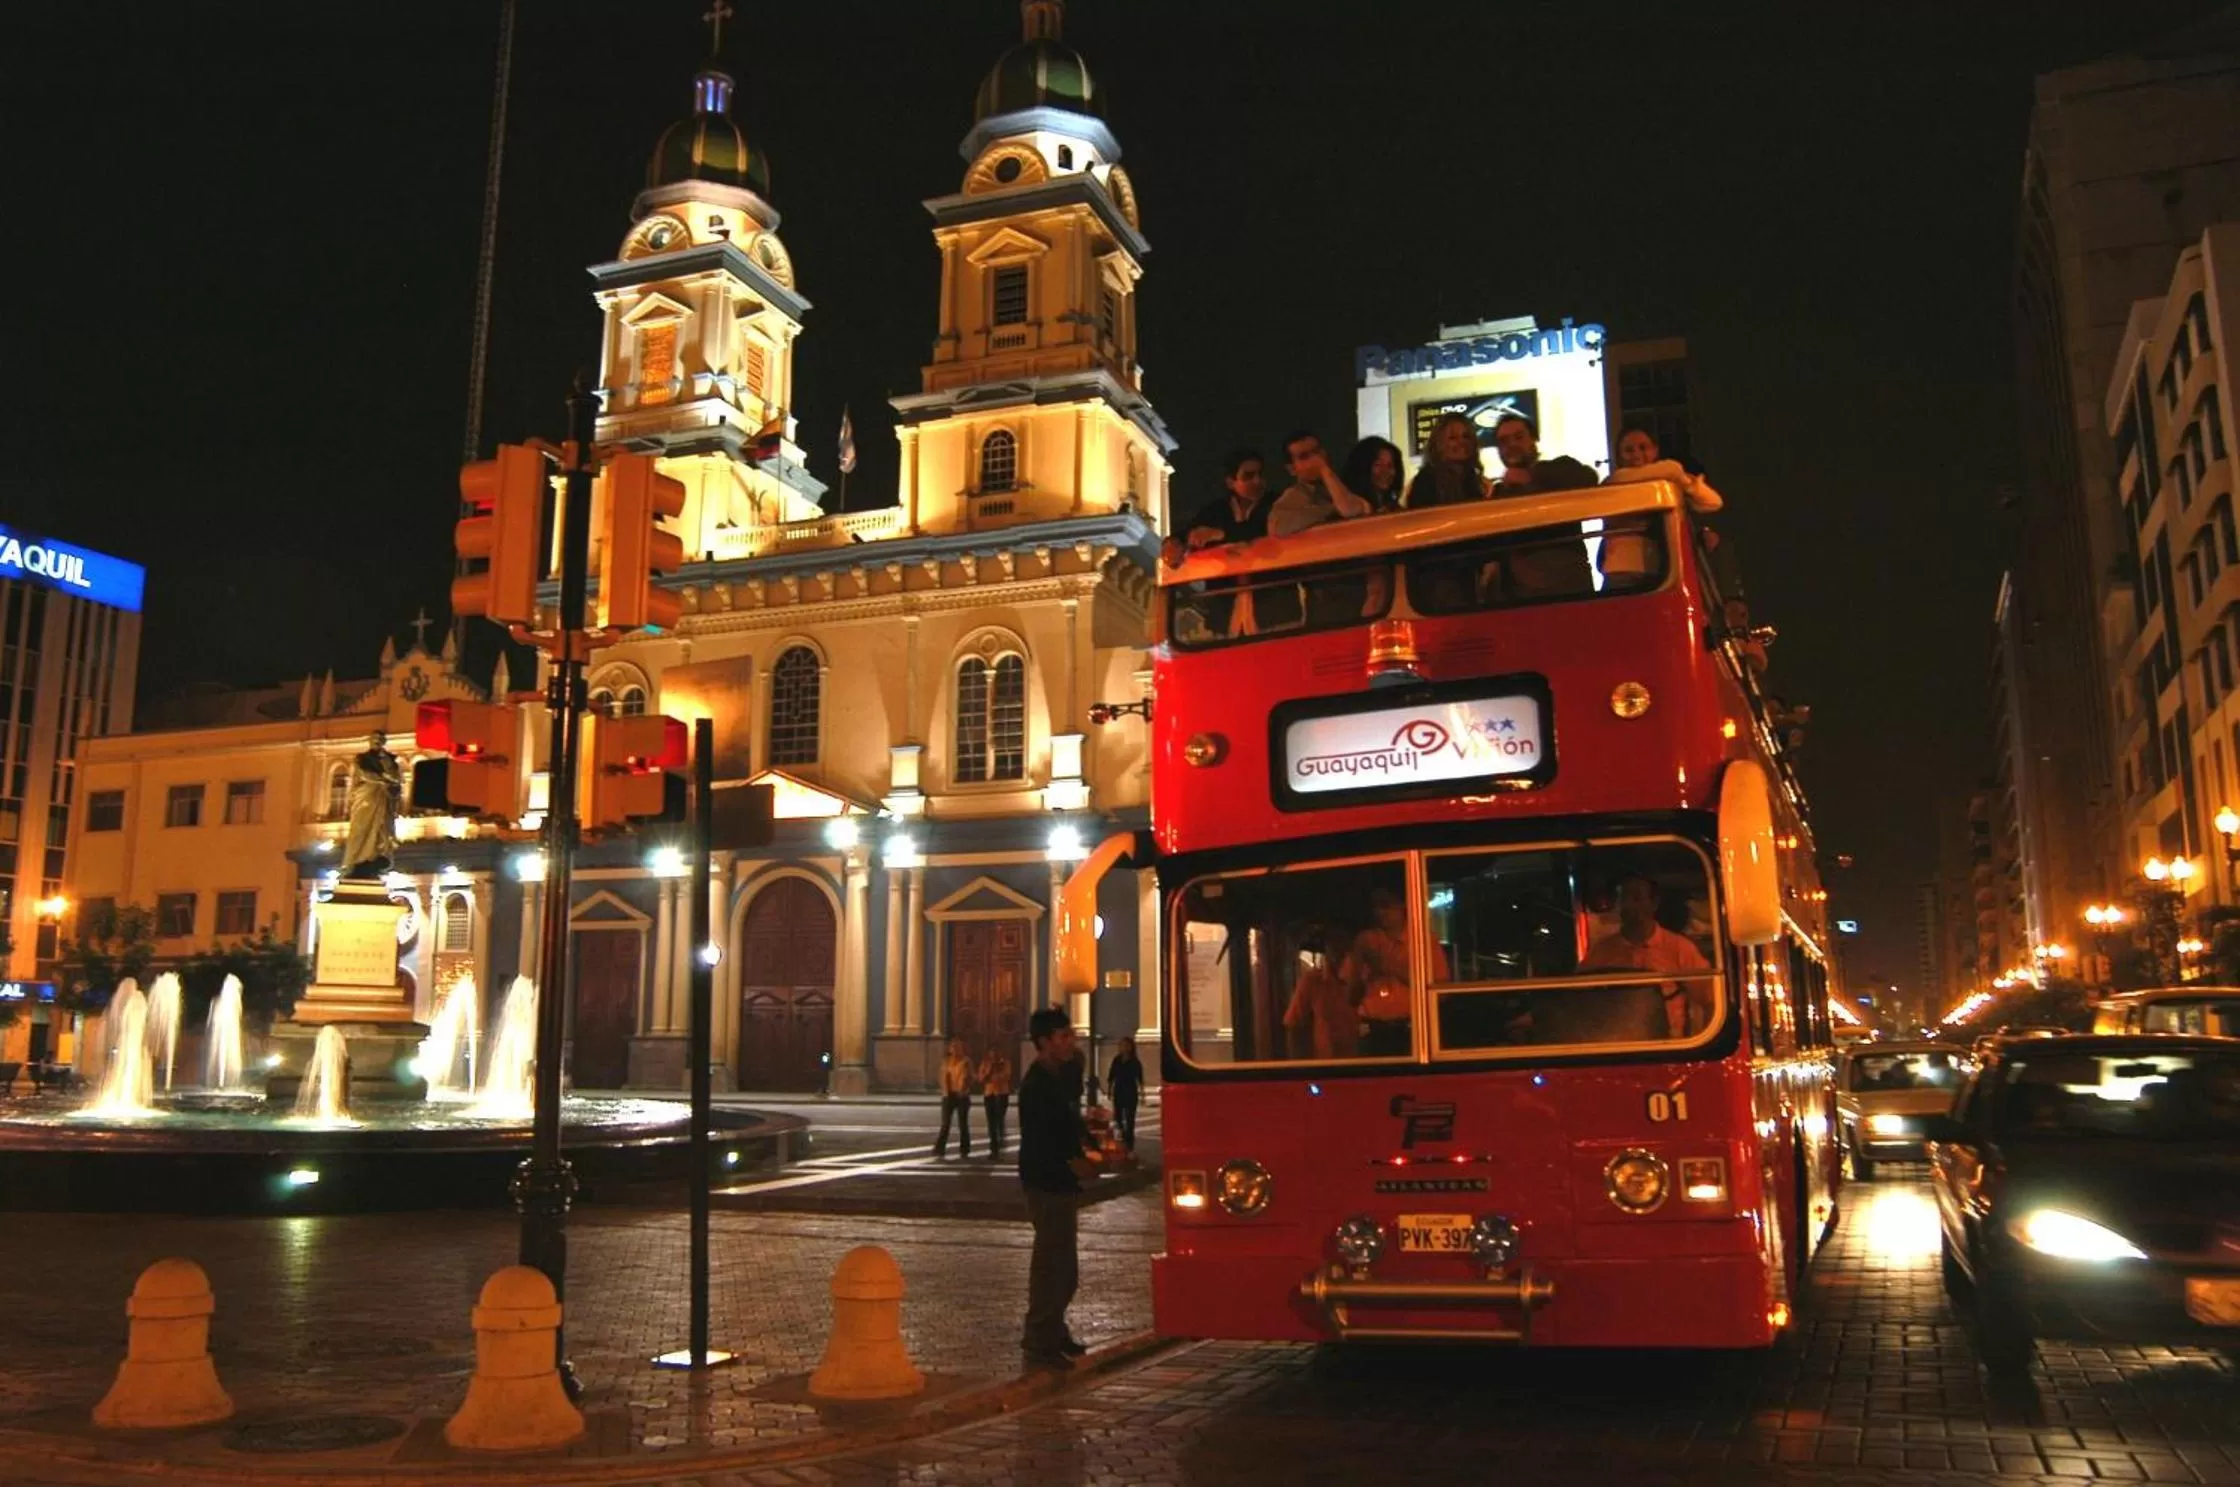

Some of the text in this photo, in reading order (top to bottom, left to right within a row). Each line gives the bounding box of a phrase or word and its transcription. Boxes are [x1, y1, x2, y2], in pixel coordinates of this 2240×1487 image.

[1356, 316, 1608, 379] Panasonic
[1296, 751, 1419, 776] Guayaquil
[0, 983, 26, 998] AL
[1648, 1092, 1688, 1122] 01
[1401, 1228, 1471, 1249] PVK-397
